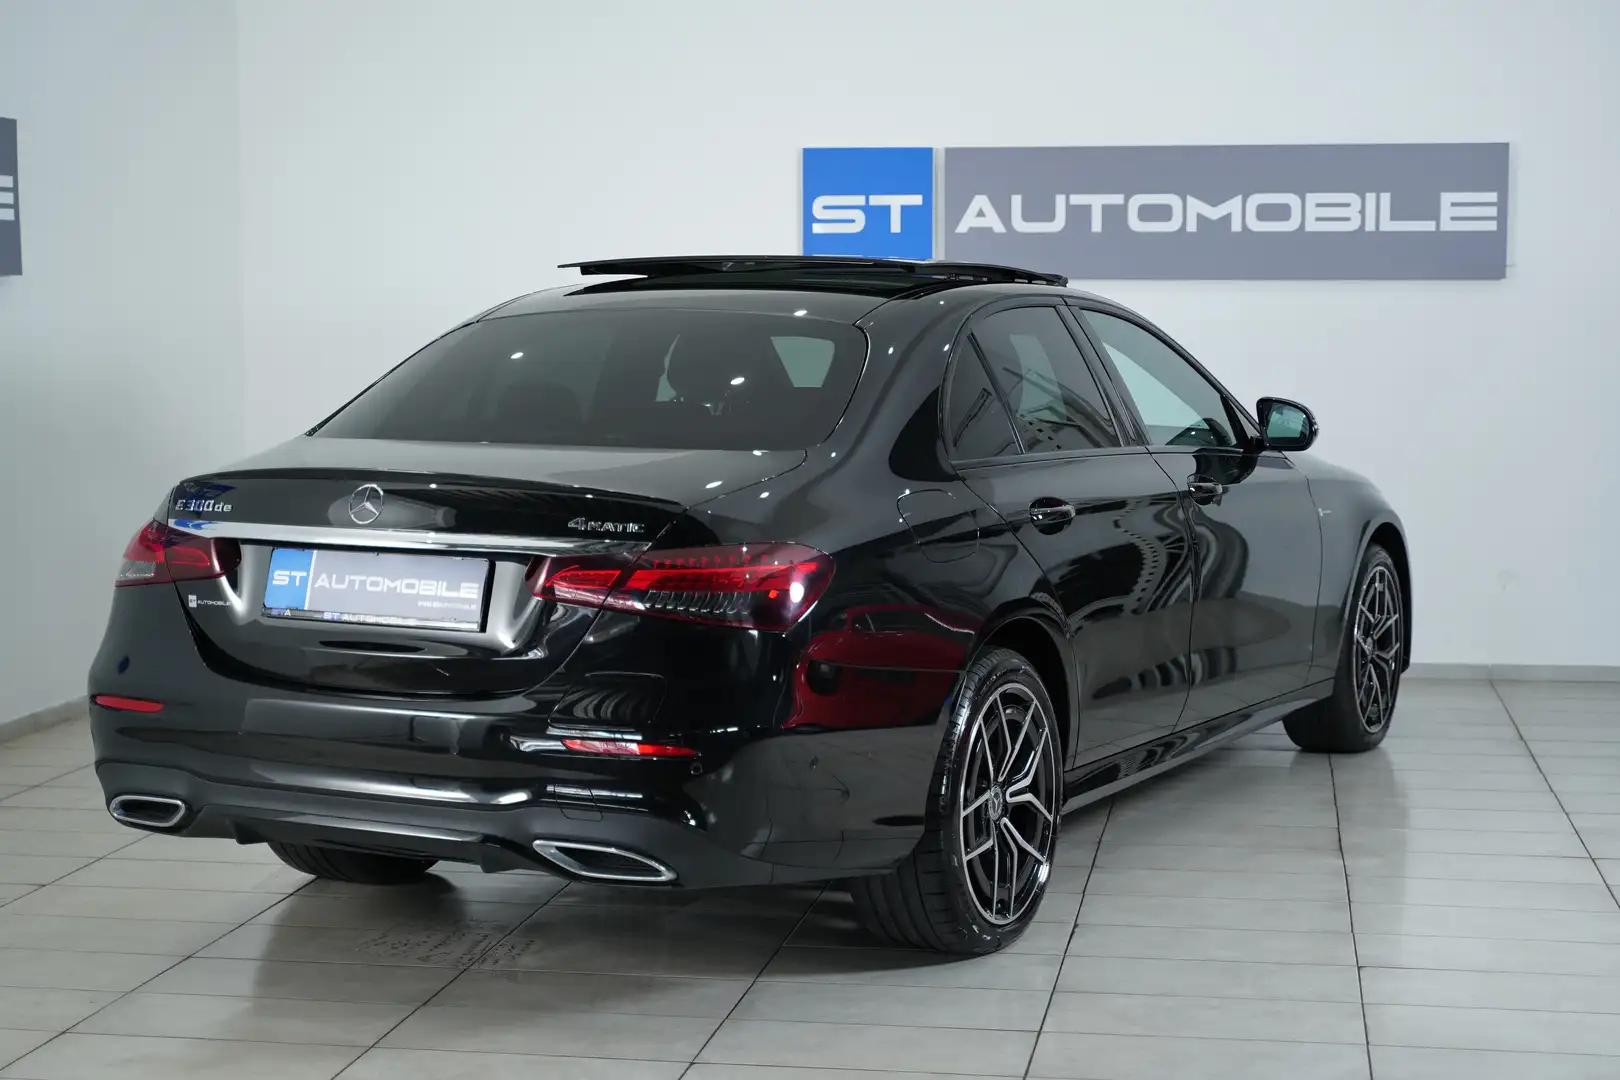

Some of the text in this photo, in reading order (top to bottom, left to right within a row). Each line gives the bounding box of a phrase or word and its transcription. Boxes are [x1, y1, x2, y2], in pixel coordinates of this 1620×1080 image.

[812, 191, 1498, 234] ST AUTOMOBILE
[567, 517, 645, 533] 4MATIC
[272, 570, 480, 599] ST AUTOMOBILE
